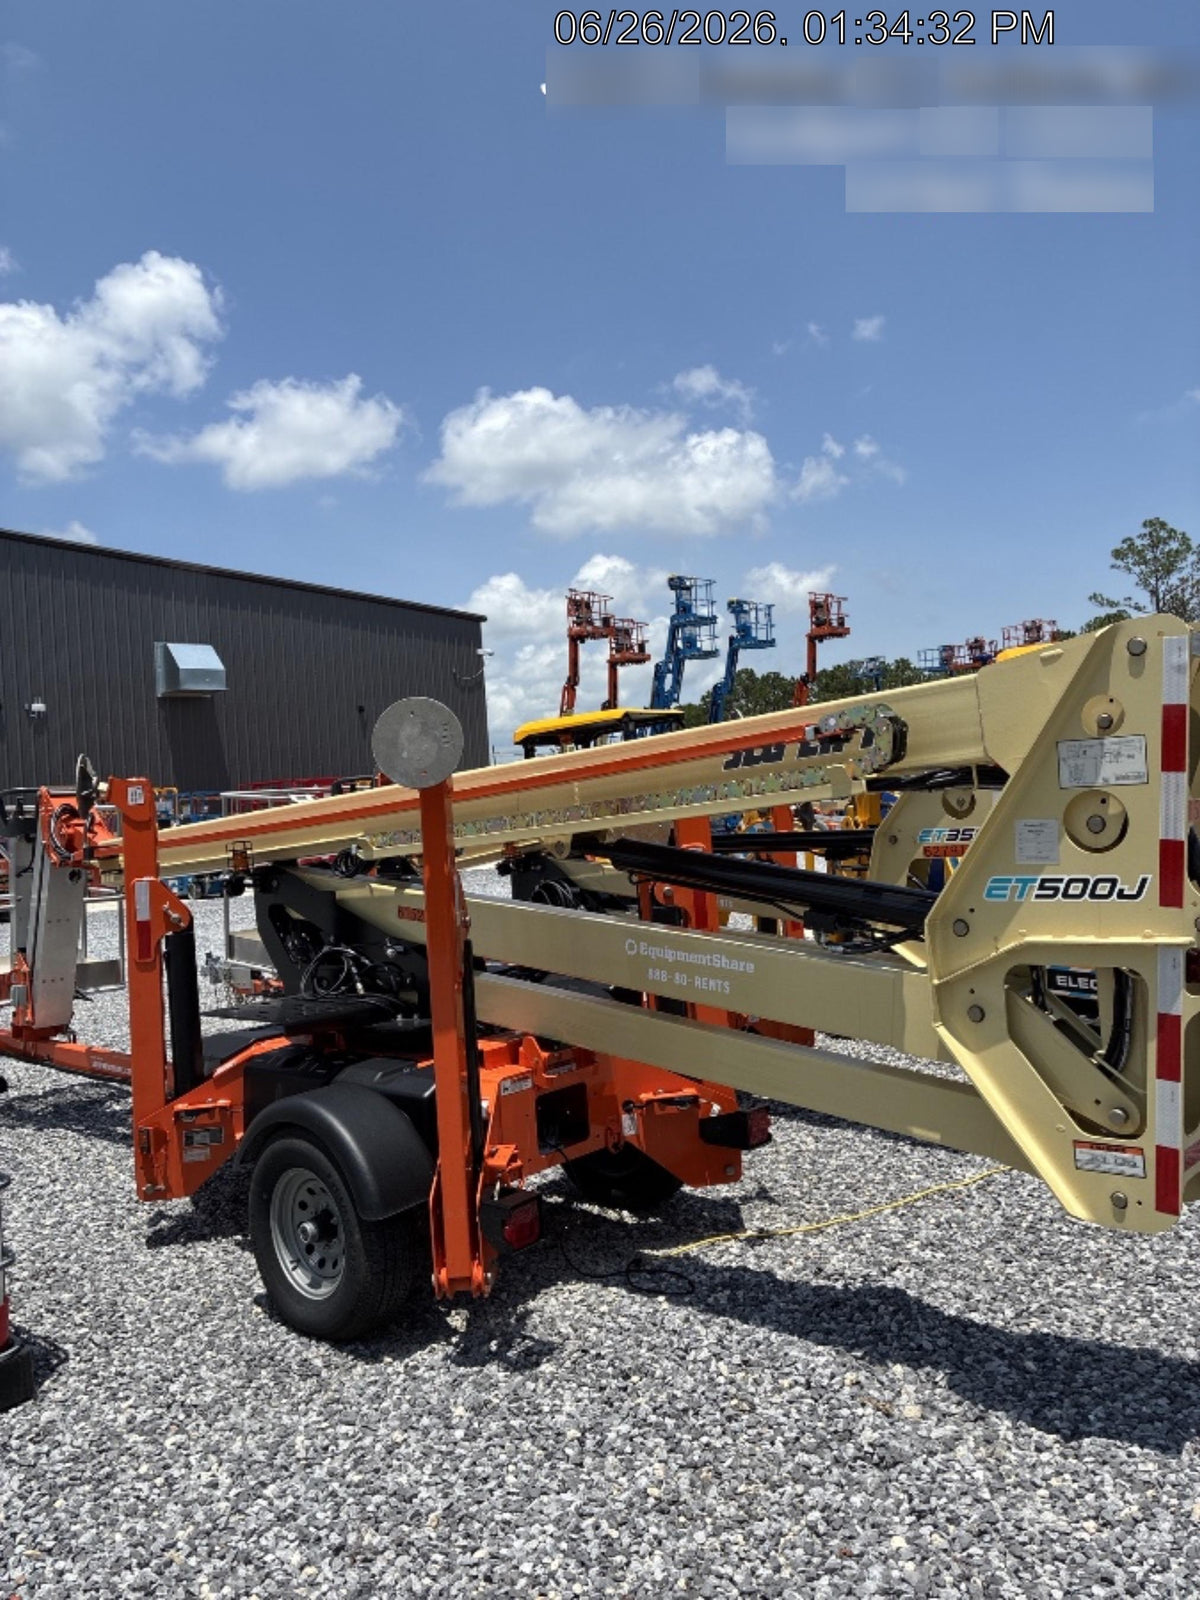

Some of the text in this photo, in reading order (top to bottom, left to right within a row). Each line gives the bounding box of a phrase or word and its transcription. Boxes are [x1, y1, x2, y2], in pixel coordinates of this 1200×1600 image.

[917, 827, 979, 843] ET35
[984, 875, 1152, 902] ET500J
[640, 942, 756, 974] EquipmentShare
